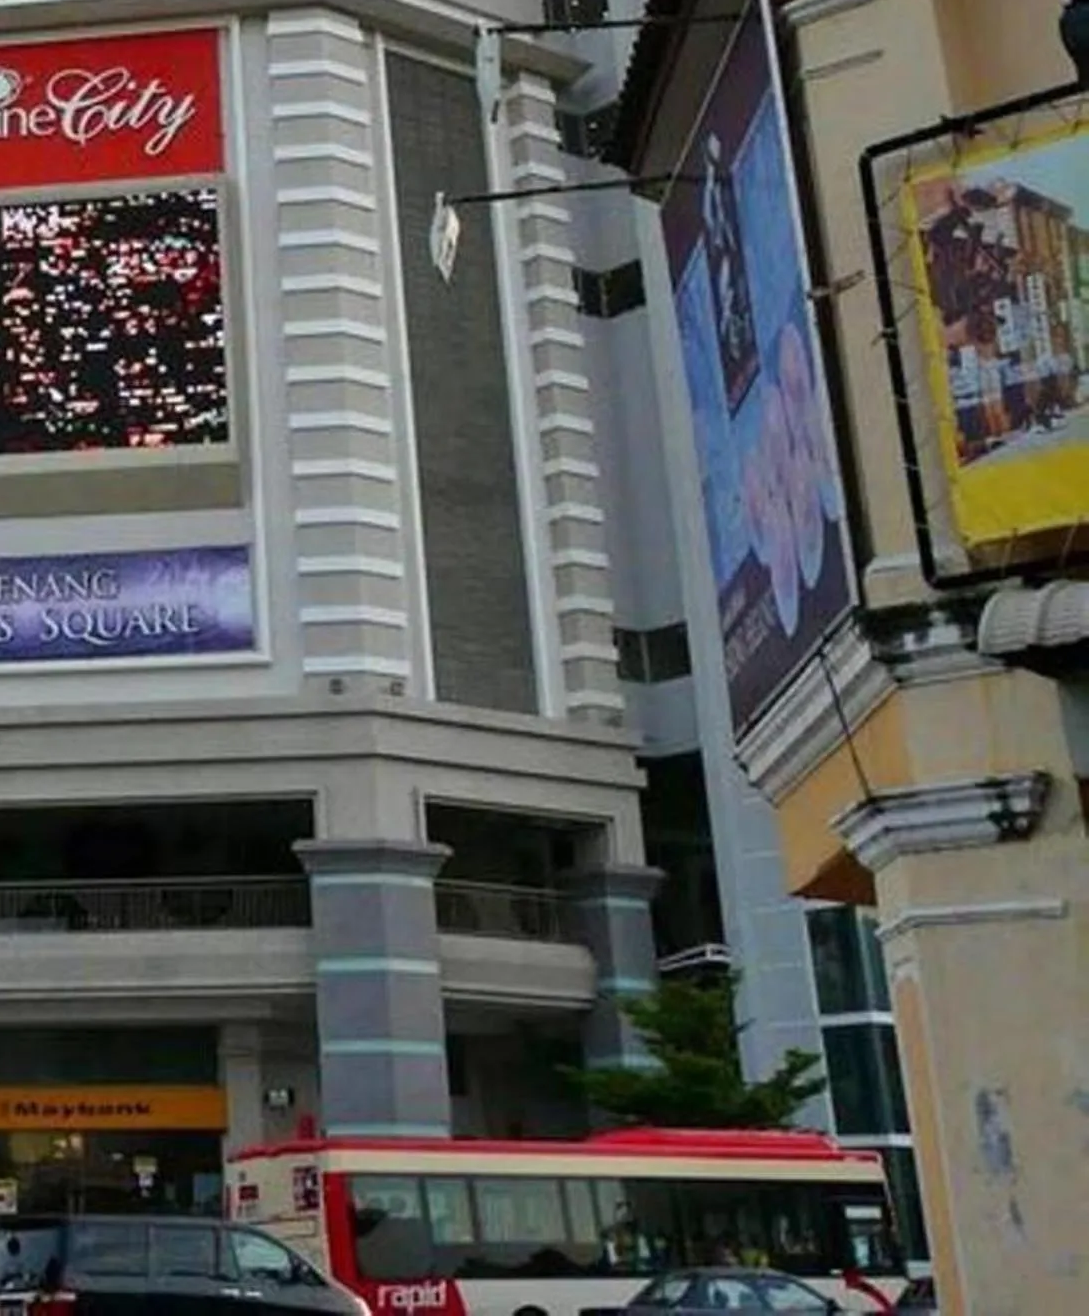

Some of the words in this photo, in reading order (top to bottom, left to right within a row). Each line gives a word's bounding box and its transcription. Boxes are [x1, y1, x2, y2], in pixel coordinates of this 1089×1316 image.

[47, 67, 194, 155] City
[39, 604, 200, 644] SQUARE
[14, 1100, 151, 1119] Maybank
[377, 1280, 446, 1315] rapid
